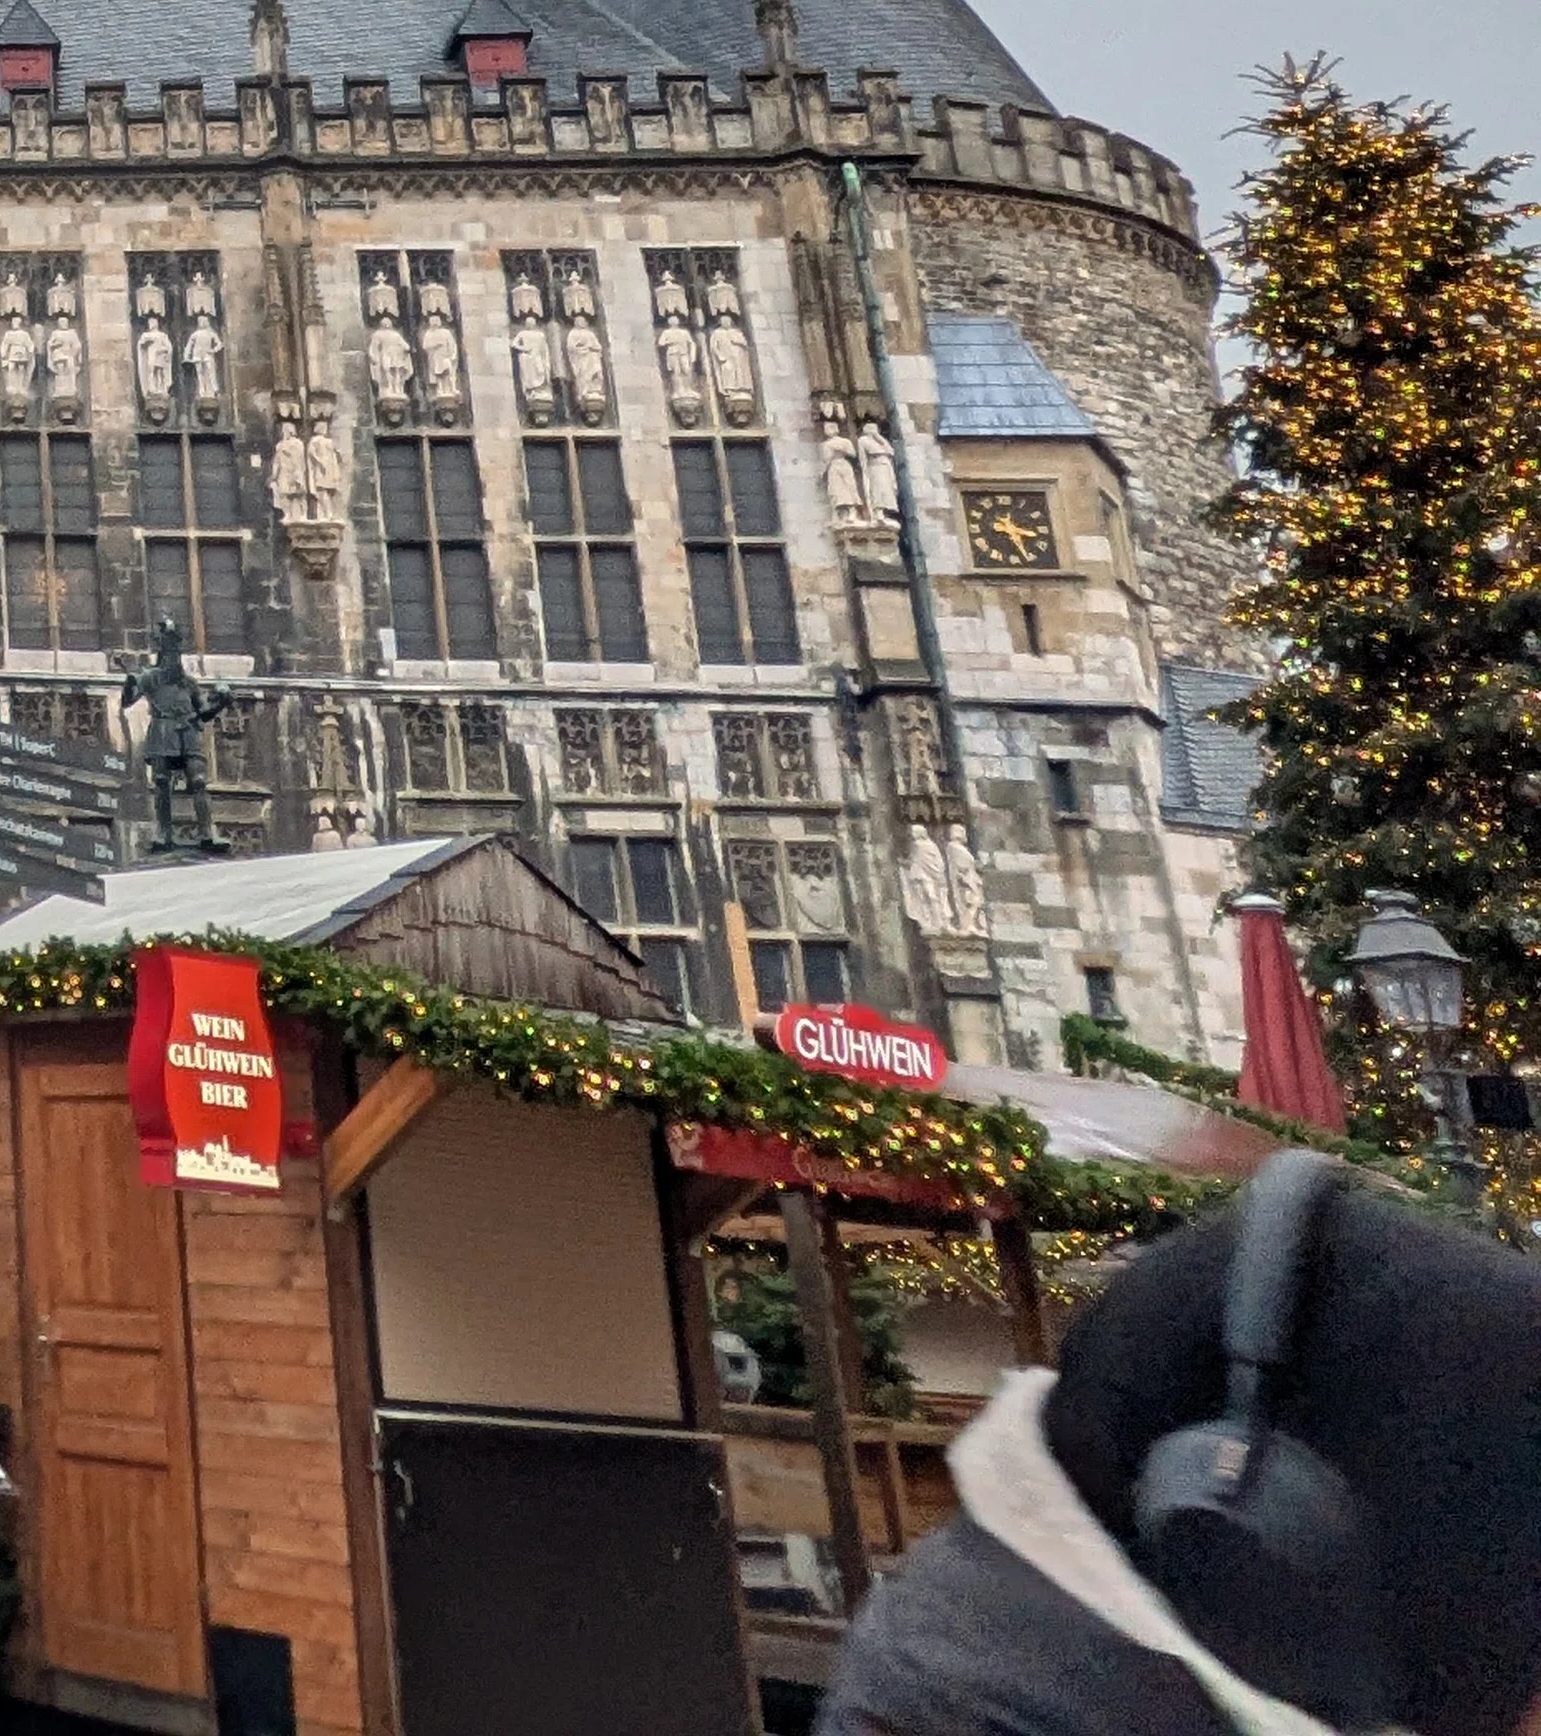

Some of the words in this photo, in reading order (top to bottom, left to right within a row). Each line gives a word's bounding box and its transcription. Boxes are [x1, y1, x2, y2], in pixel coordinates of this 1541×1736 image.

[191, 1012, 245, 1042] WEIN
[167, 1041, 274, 1079] GLÜHWEIN
[796, 1017, 934, 1081] GLÜHWEIN
[200, 1081, 249, 1109] BIER
